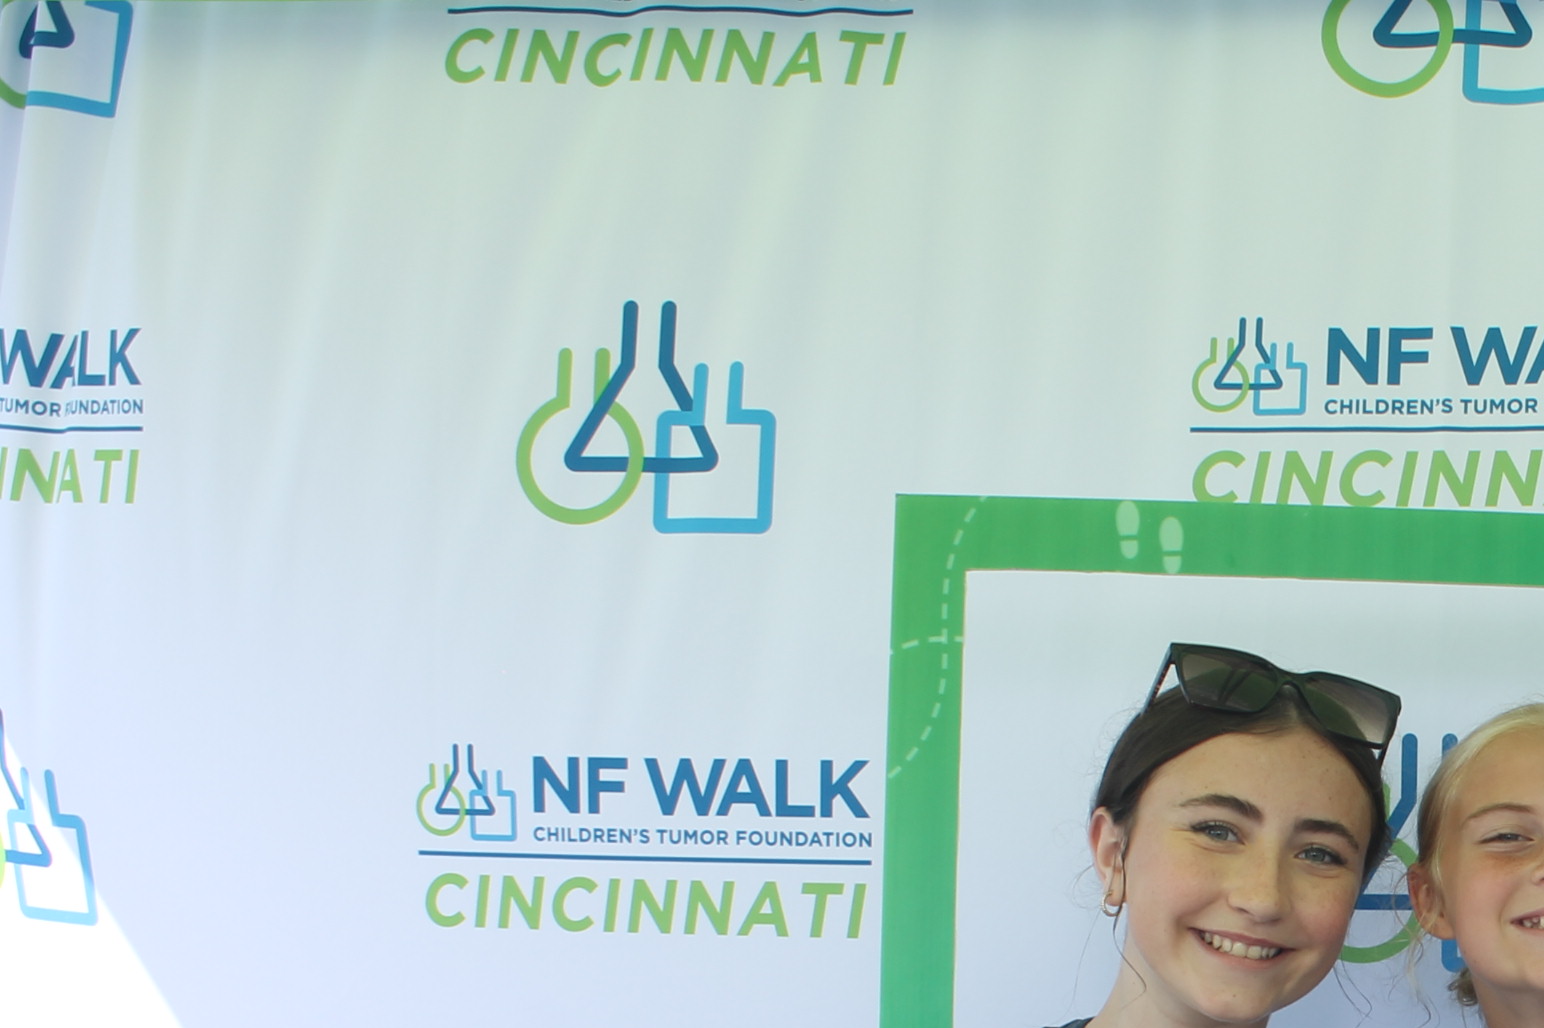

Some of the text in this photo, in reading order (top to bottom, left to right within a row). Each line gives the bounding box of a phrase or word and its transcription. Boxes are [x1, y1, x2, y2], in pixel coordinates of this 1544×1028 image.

[444, 27, 907, 87] CINCINNATI
[1325, 325, 1434, 386] NF
[65, 399, 144, 416] FUNDATION
[1323, 397, 1453, 416] CHILDREN'S
[1460, 397, 1538, 415] TUMOR
[532, 756, 871, 819] NF WALK
[532, 826, 873, 849] CHILDREN'S TUMOR FOUNDATION
[425, 872, 867, 939] CINCINNATI
